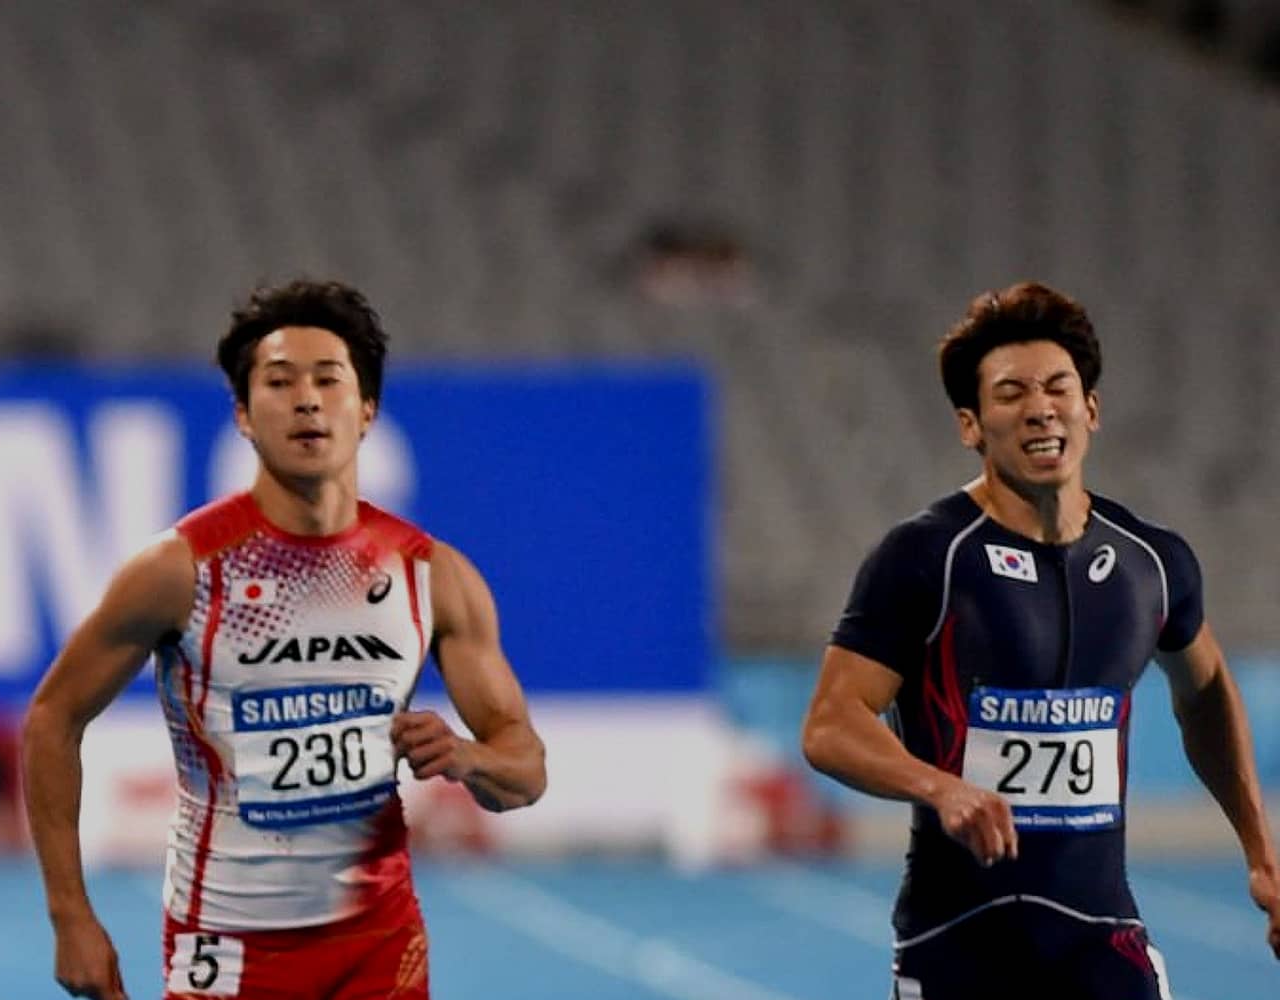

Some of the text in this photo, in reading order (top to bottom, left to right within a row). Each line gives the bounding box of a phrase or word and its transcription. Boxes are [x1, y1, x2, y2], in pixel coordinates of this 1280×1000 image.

[238, 635, 404, 664] JAPAN
[980, 696, 1114, 724] SAMSUNG
[269, 727, 366, 790] 230
[997, 740, 1094, 795] 279
[188, 935, 219, 989] 5
